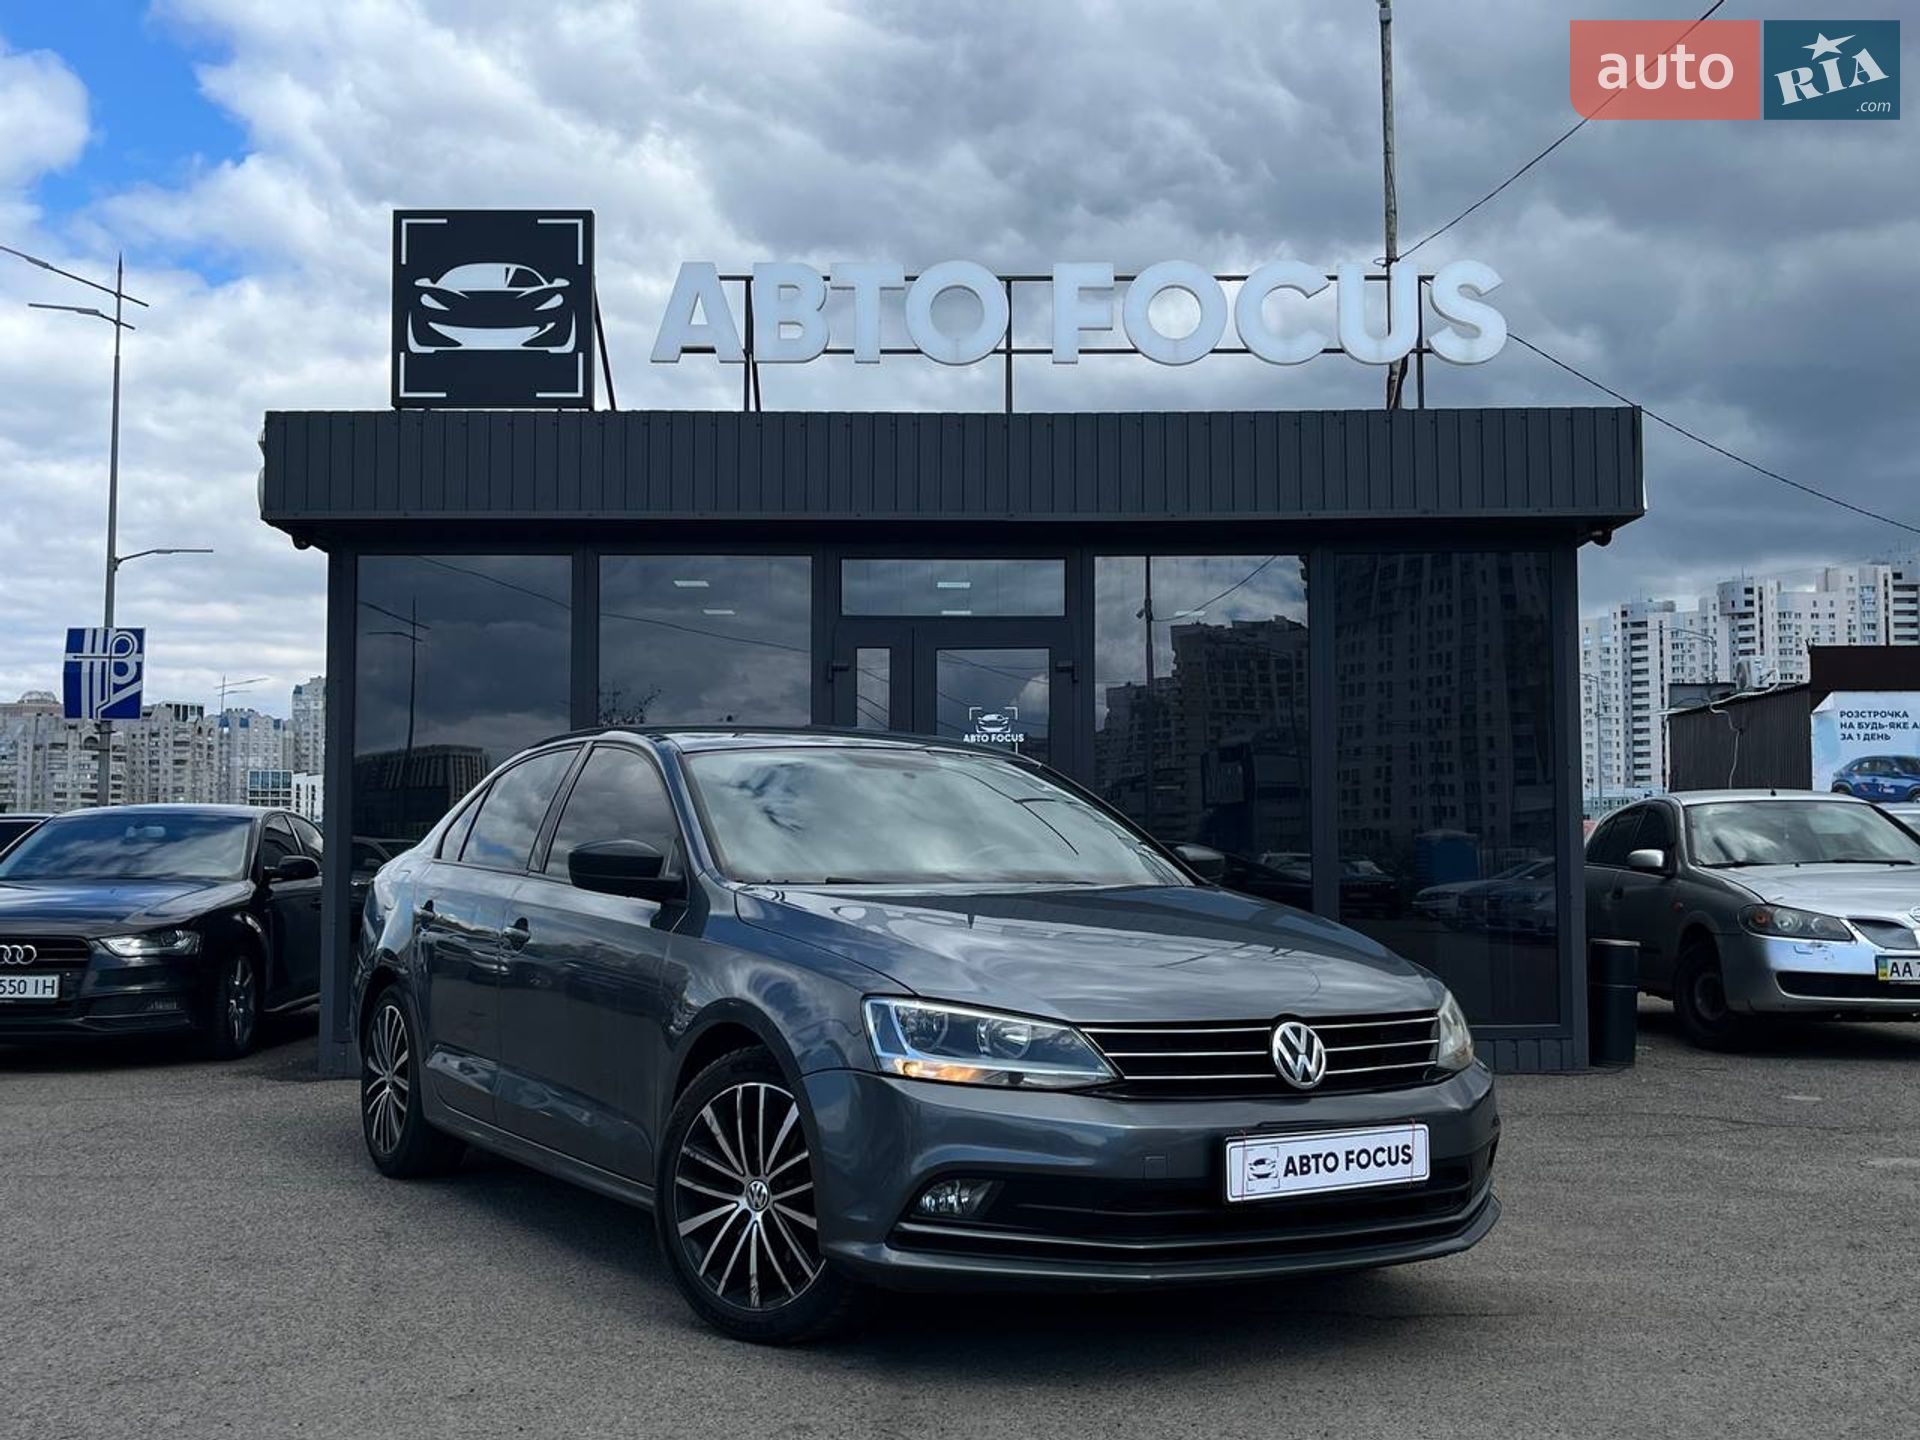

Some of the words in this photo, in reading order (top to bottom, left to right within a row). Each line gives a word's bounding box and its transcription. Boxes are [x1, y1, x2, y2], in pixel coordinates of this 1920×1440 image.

[650, 260, 1009, 366] АВТО
[1052, 259, 1508, 366] FOCUS
[1839, 710, 1909, 719] РОЗСТРОЧКА
[1840, 722, 1855, 730] НА
[1857, 721, 1910, 731] БУДЬ-ЯКЕ
[963, 733, 990, 743] АВТО
[991, 733, 1025, 743] FOCUS
[1840, 733, 1854, 741] ЗА
[1862, 733, 1892, 742] ДЕНЬ
[1283, 1151, 1340, 1178] АВТО
[1344, 1143, 1414, 1172] FOCUS
